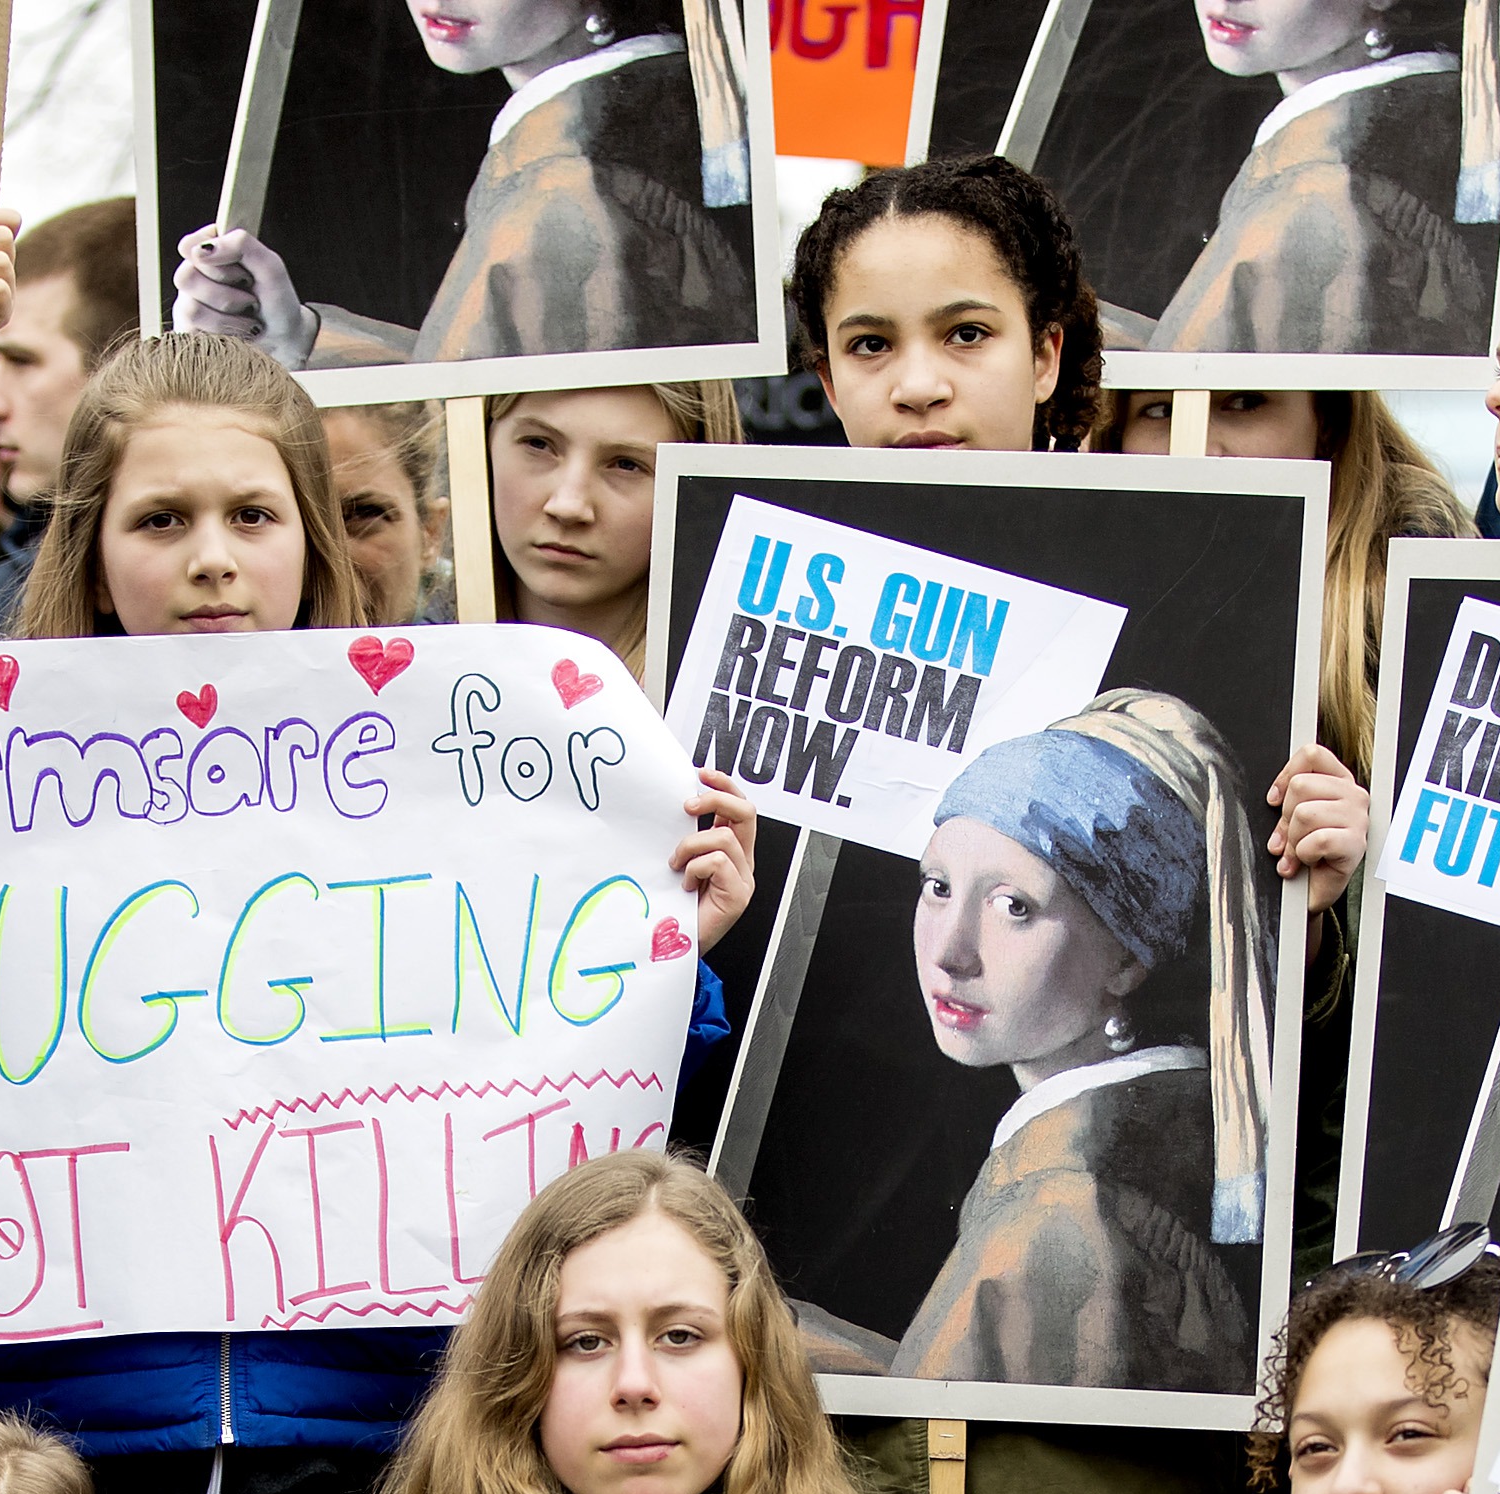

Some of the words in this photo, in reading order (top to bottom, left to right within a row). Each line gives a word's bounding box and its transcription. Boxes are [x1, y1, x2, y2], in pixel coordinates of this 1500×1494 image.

[737, 534, 846, 638] U.S.
[870, 572, 1009, 677] GUN
[432, 672, 625, 811] for
[692, 691, 860, 809] NOW.
[713, 613, 982, 754] REFORM
